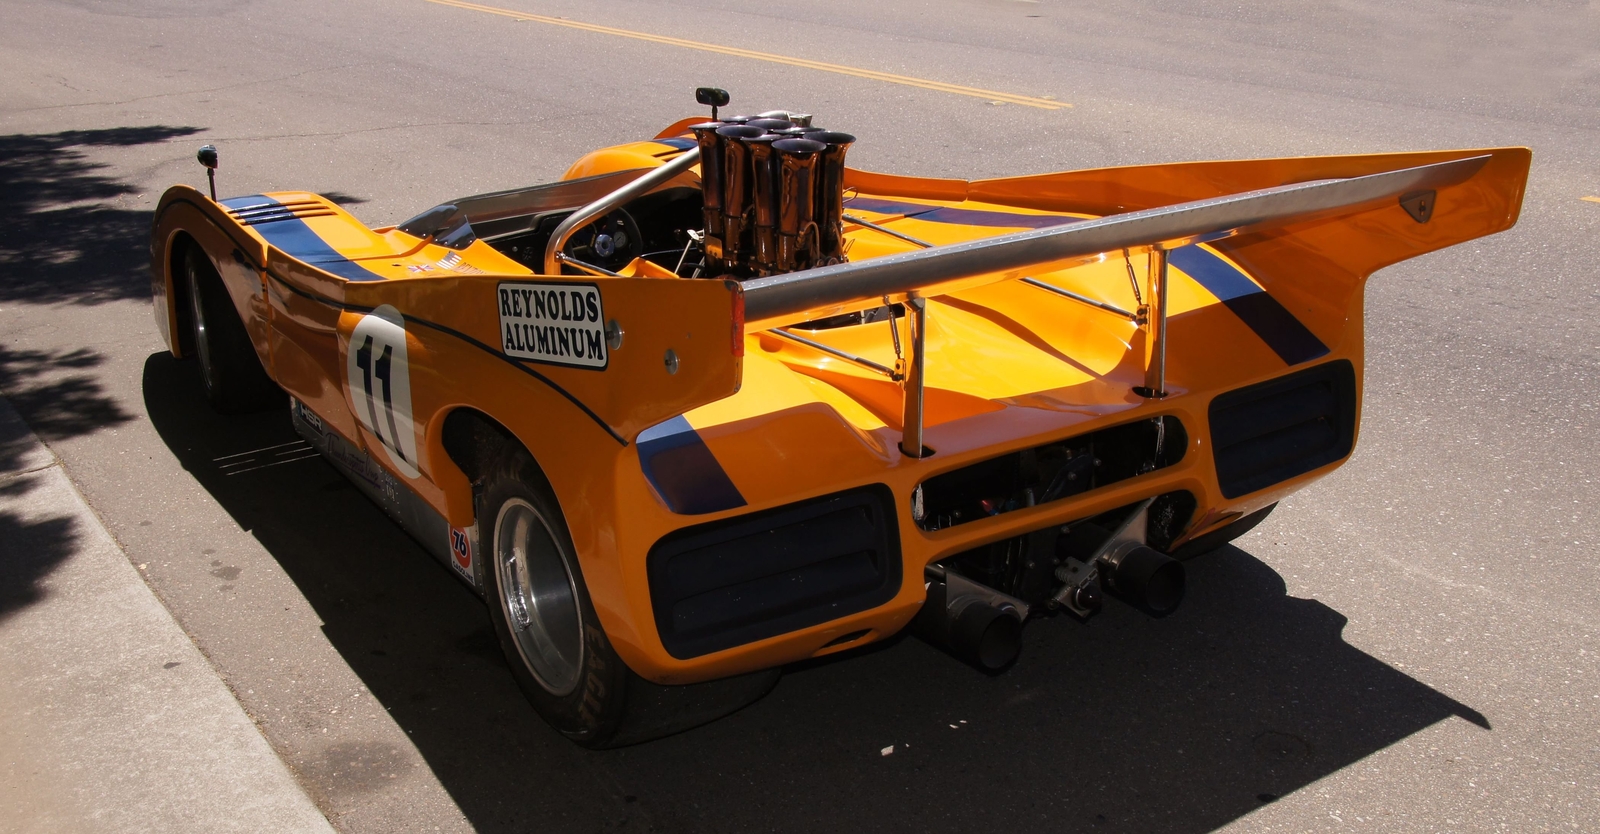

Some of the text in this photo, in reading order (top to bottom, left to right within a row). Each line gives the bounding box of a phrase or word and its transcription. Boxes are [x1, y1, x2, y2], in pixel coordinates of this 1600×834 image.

[500, 289, 598, 322] REYNOLDS
[505, 322, 604, 360] ALUMINUM
[357, 335, 407, 463] 11
[453, 529, 467, 557] 76
[452, 560, 474, 583] GASOLINE
